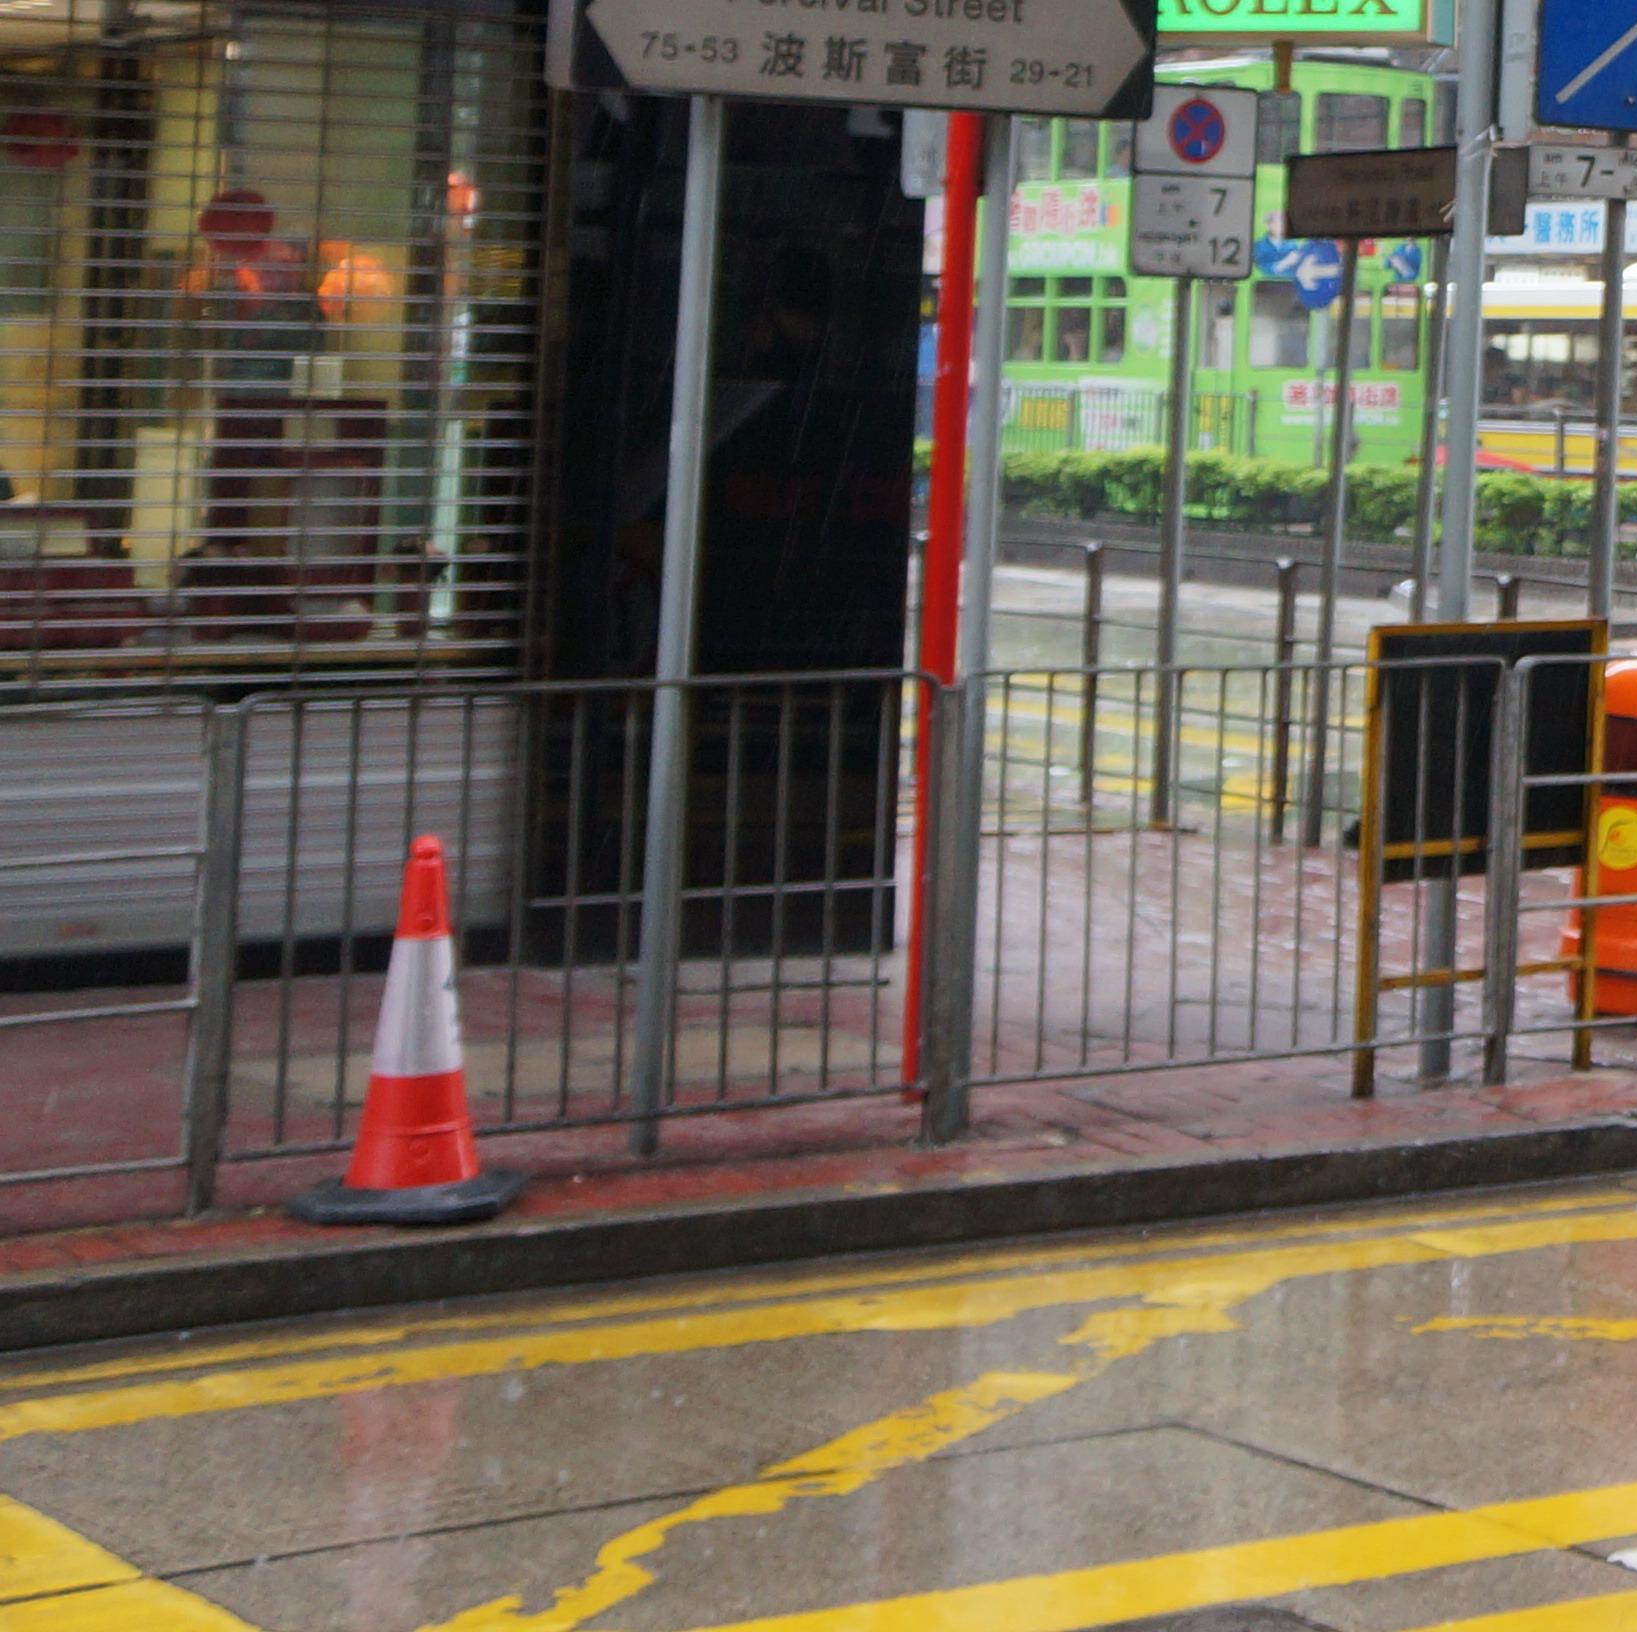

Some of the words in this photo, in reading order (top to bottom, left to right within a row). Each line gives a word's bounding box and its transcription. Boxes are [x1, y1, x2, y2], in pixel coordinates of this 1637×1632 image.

[640, 31, 740, 65] 75-53
[758, 29, 988, 93] 波斯富街
[1008, 58, 1095, 89] 29-21
[1209, 188, 1229, 217] 7
[1208, 238, 1241, 266] 12
